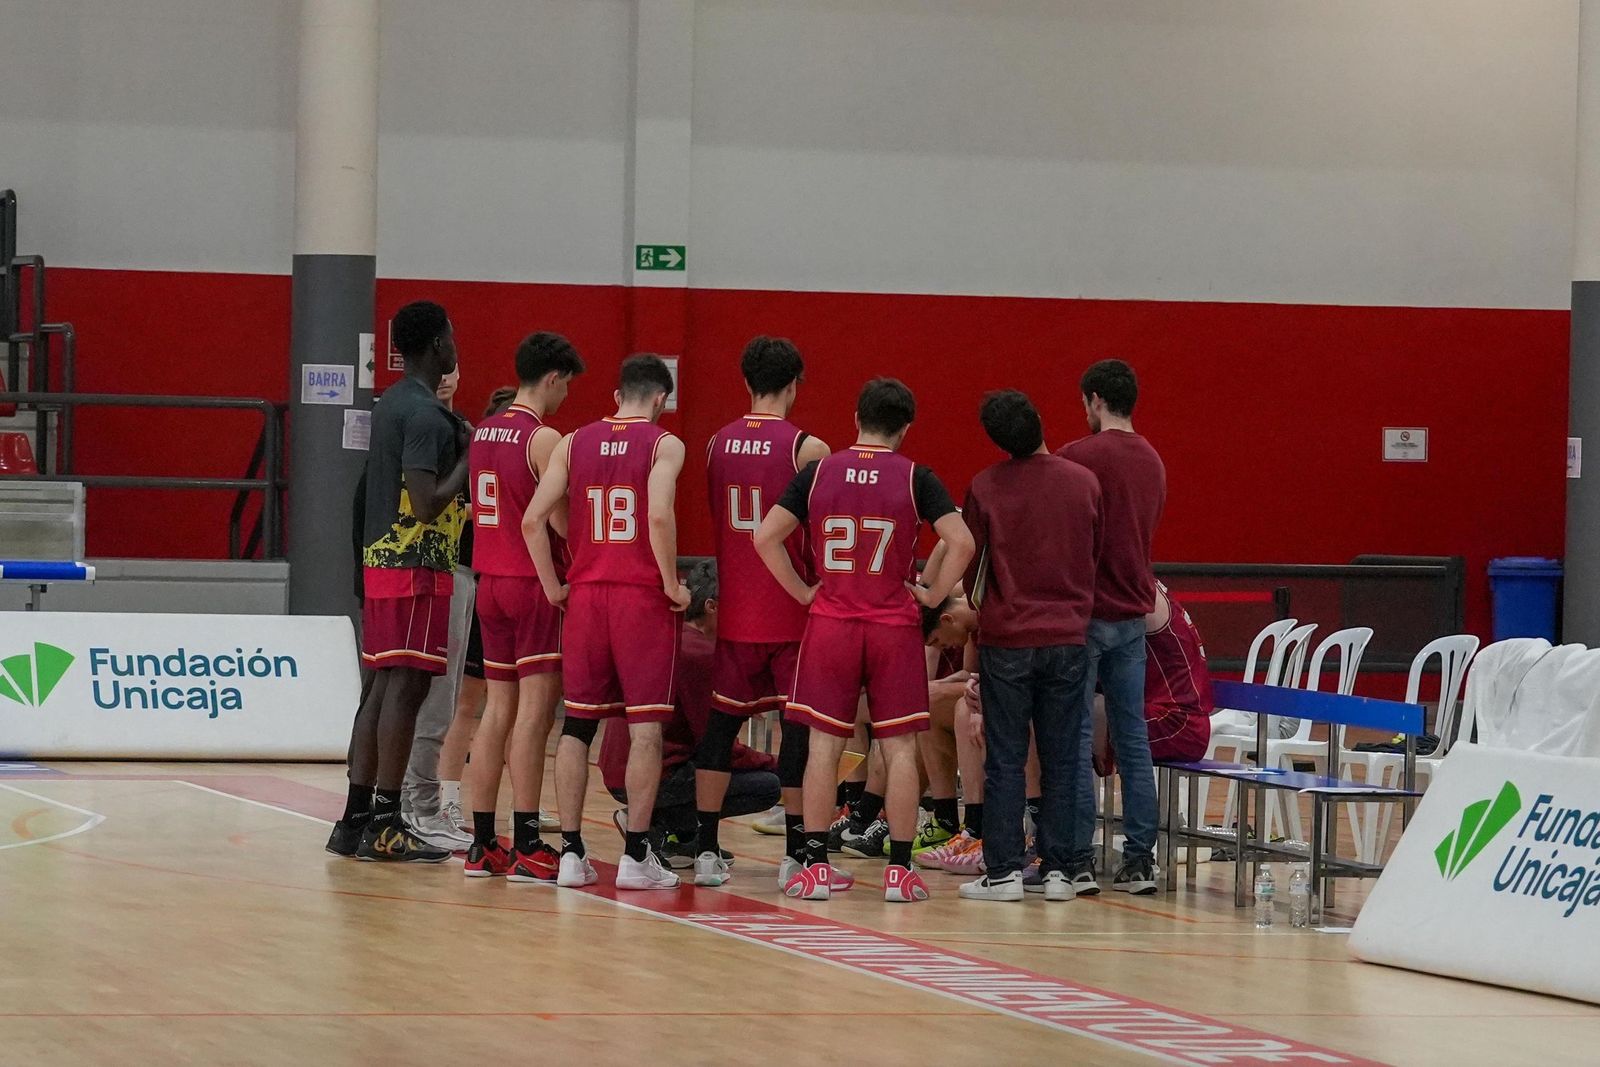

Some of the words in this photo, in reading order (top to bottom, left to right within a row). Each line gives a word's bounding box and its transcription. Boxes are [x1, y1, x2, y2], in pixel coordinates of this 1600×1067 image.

[308, 371, 347, 388] BARRA
[473, 427, 521, 444] MONTULL
[600, 440, 629, 457] BRU
[724, 438, 772, 455] IBARS
[845, 467, 880, 484] ROS
[476, 470, 499, 528] 9
[586, 485, 638, 544] 18
[727, 485, 763, 542] 4
[822, 515, 897, 575] 27
[89, 647, 298, 678] Fundación
[92, 680, 243, 719] Unicaja
[1493, 845, 1600, 918] Unicaja
